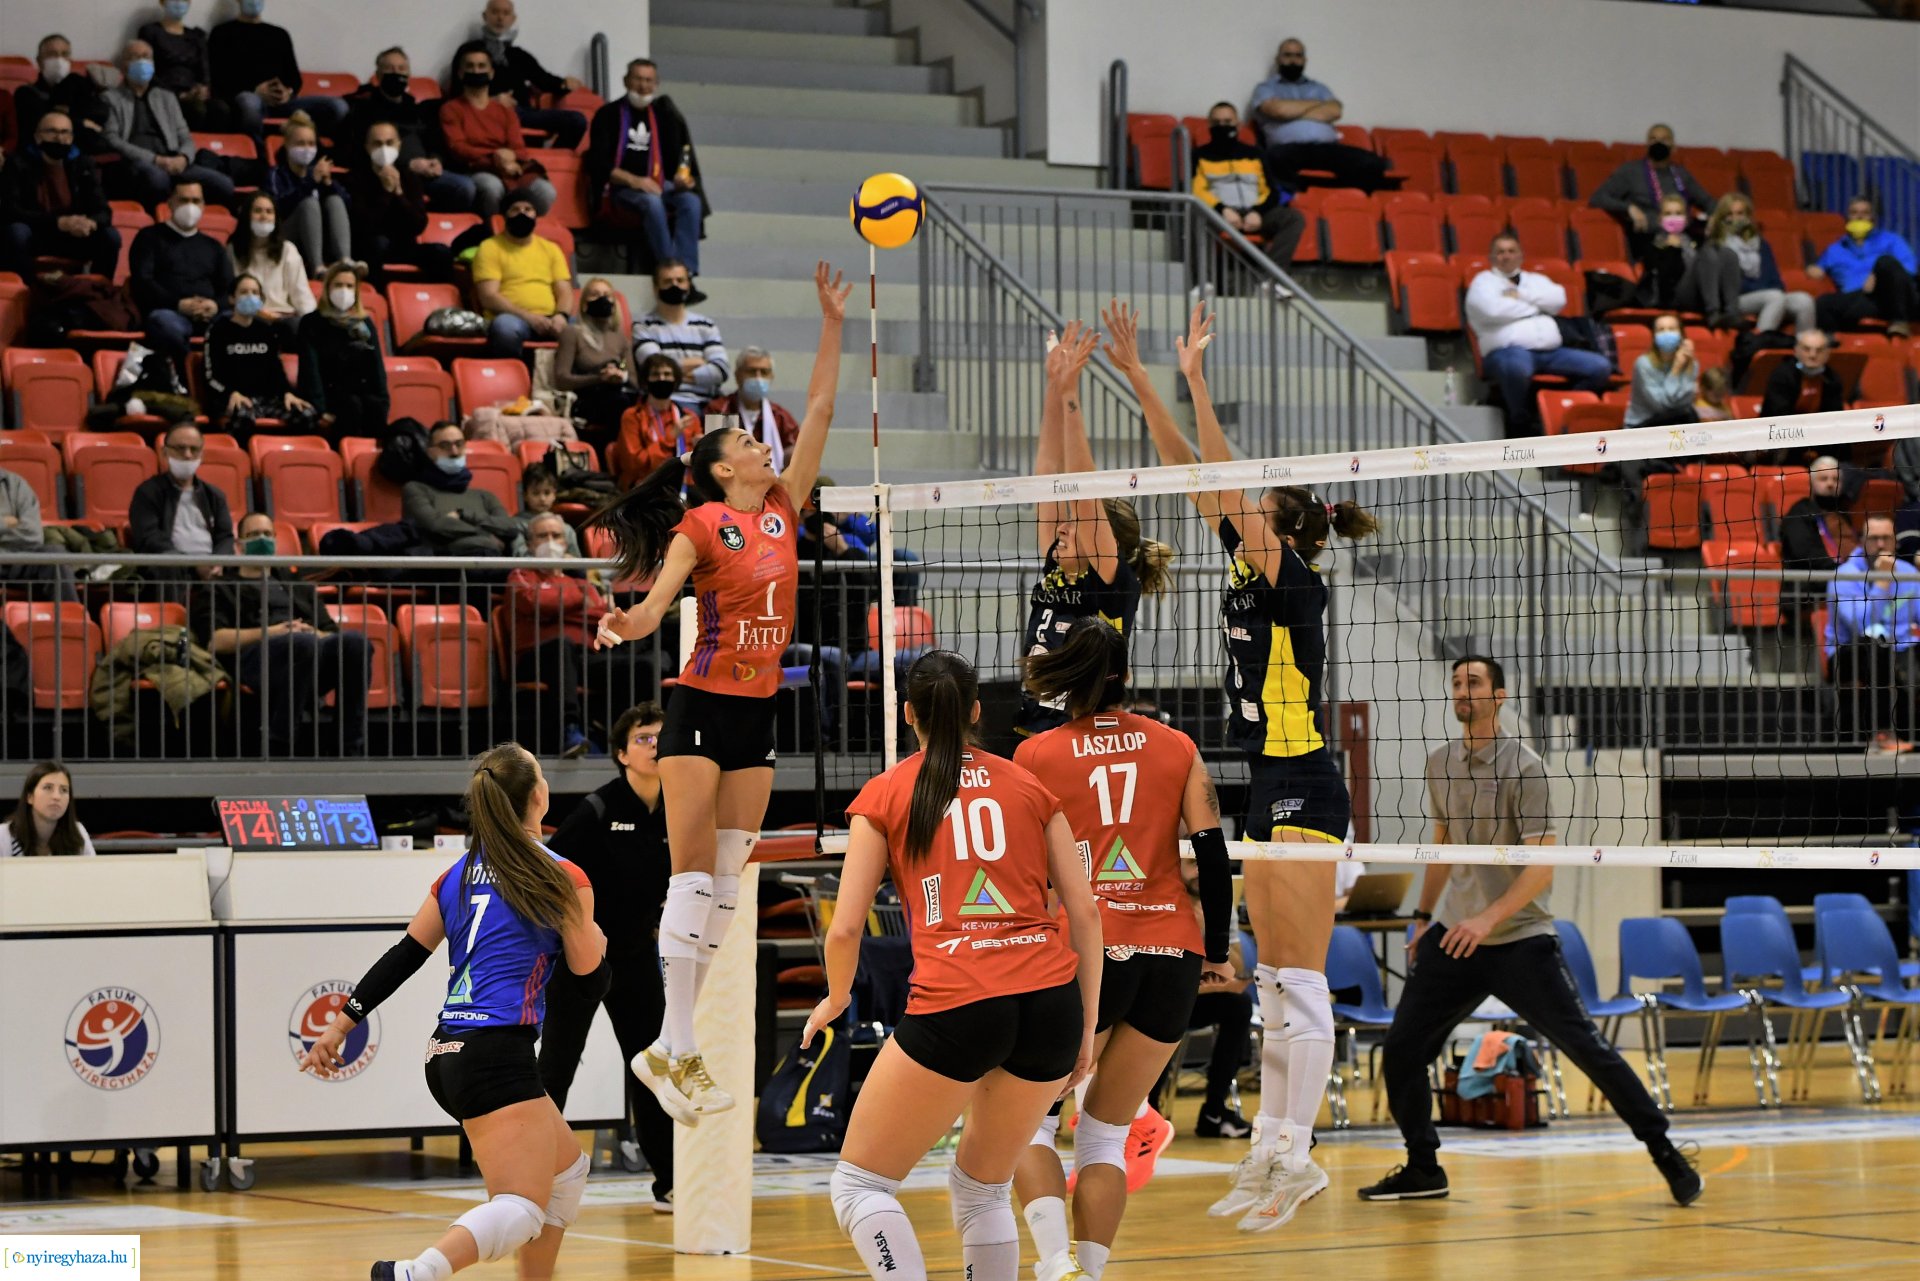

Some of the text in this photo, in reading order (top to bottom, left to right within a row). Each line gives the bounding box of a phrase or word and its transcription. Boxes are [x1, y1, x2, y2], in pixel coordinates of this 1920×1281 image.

[1768, 424, 1804, 439] FATUM
[1503, 446, 1535, 460] FATUM
[1263, 464, 1292, 479] FATUM
[1053, 479, 1080, 494] FATUM
[736, 620, 788, 645] FATU
[1071, 732, 1147, 757] LÁSZLOP
[1088, 762, 1138, 826] 17
[219, 801, 269, 812] FATUM
[229, 813, 276, 845] 14
[326, 812, 373, 845] 13
[942, 797, 1007, 861] 10
[1096, 882, 1133, 892] KE-VIZ
[928, 877, 938, 922] STRABAG
[1107, 900, 1177, 912] BESTRONG
[466, 893, 491, 954] 7
[971, 933, 1047, 950] BESTRONG
[89, 989, 136, 1006] FATUM
[873, 1230, 897, 1273] MIKASA
